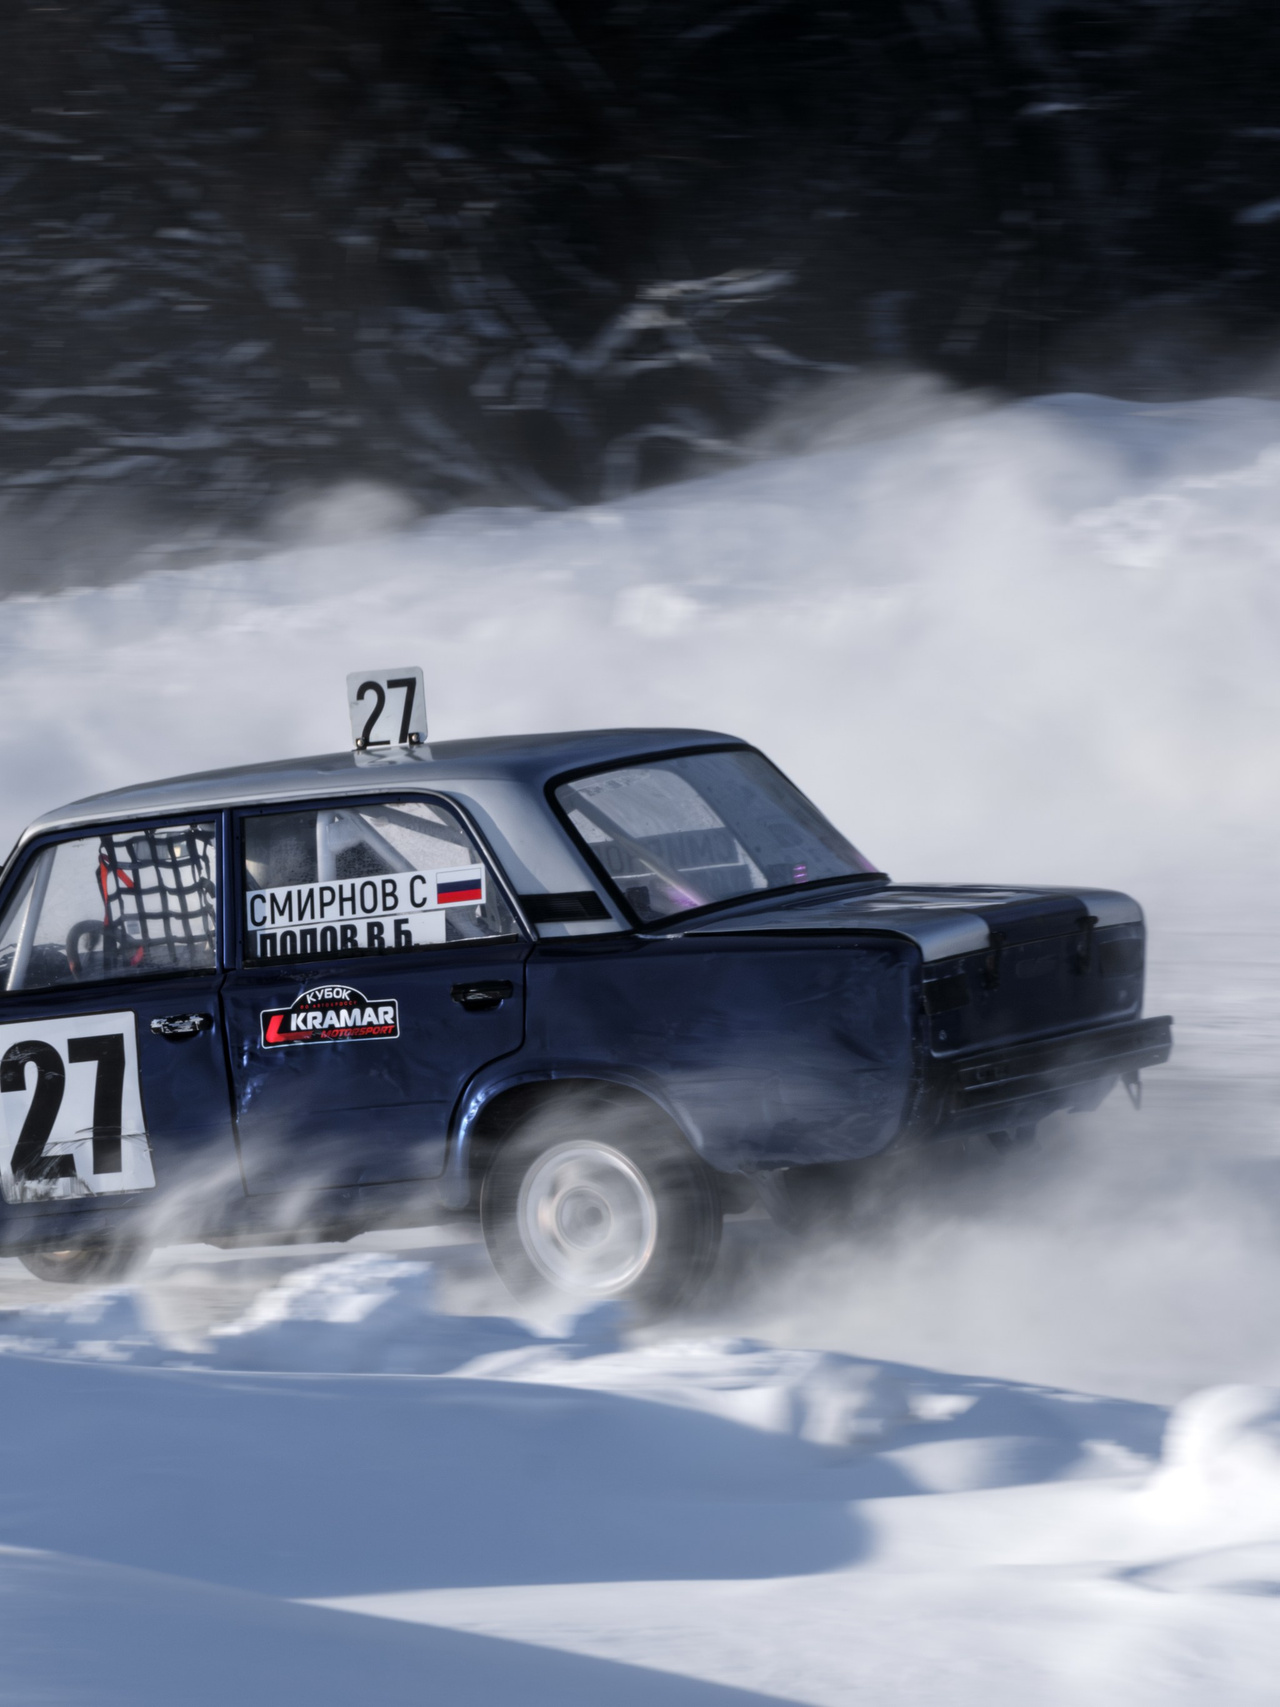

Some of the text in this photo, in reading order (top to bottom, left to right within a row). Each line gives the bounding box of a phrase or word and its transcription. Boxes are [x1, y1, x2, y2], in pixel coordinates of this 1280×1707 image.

[356, 677, 417, 746] 27
[249, 874, 428, 928] СМИРНОВ С
[306, 987, 352, 1004] КУБОК
[290, 1006, 396, 1032] KRAMAR
[320, 1025, 395, 1039] MOTORSPORT
[0, 1033, 126, 1181] 27
